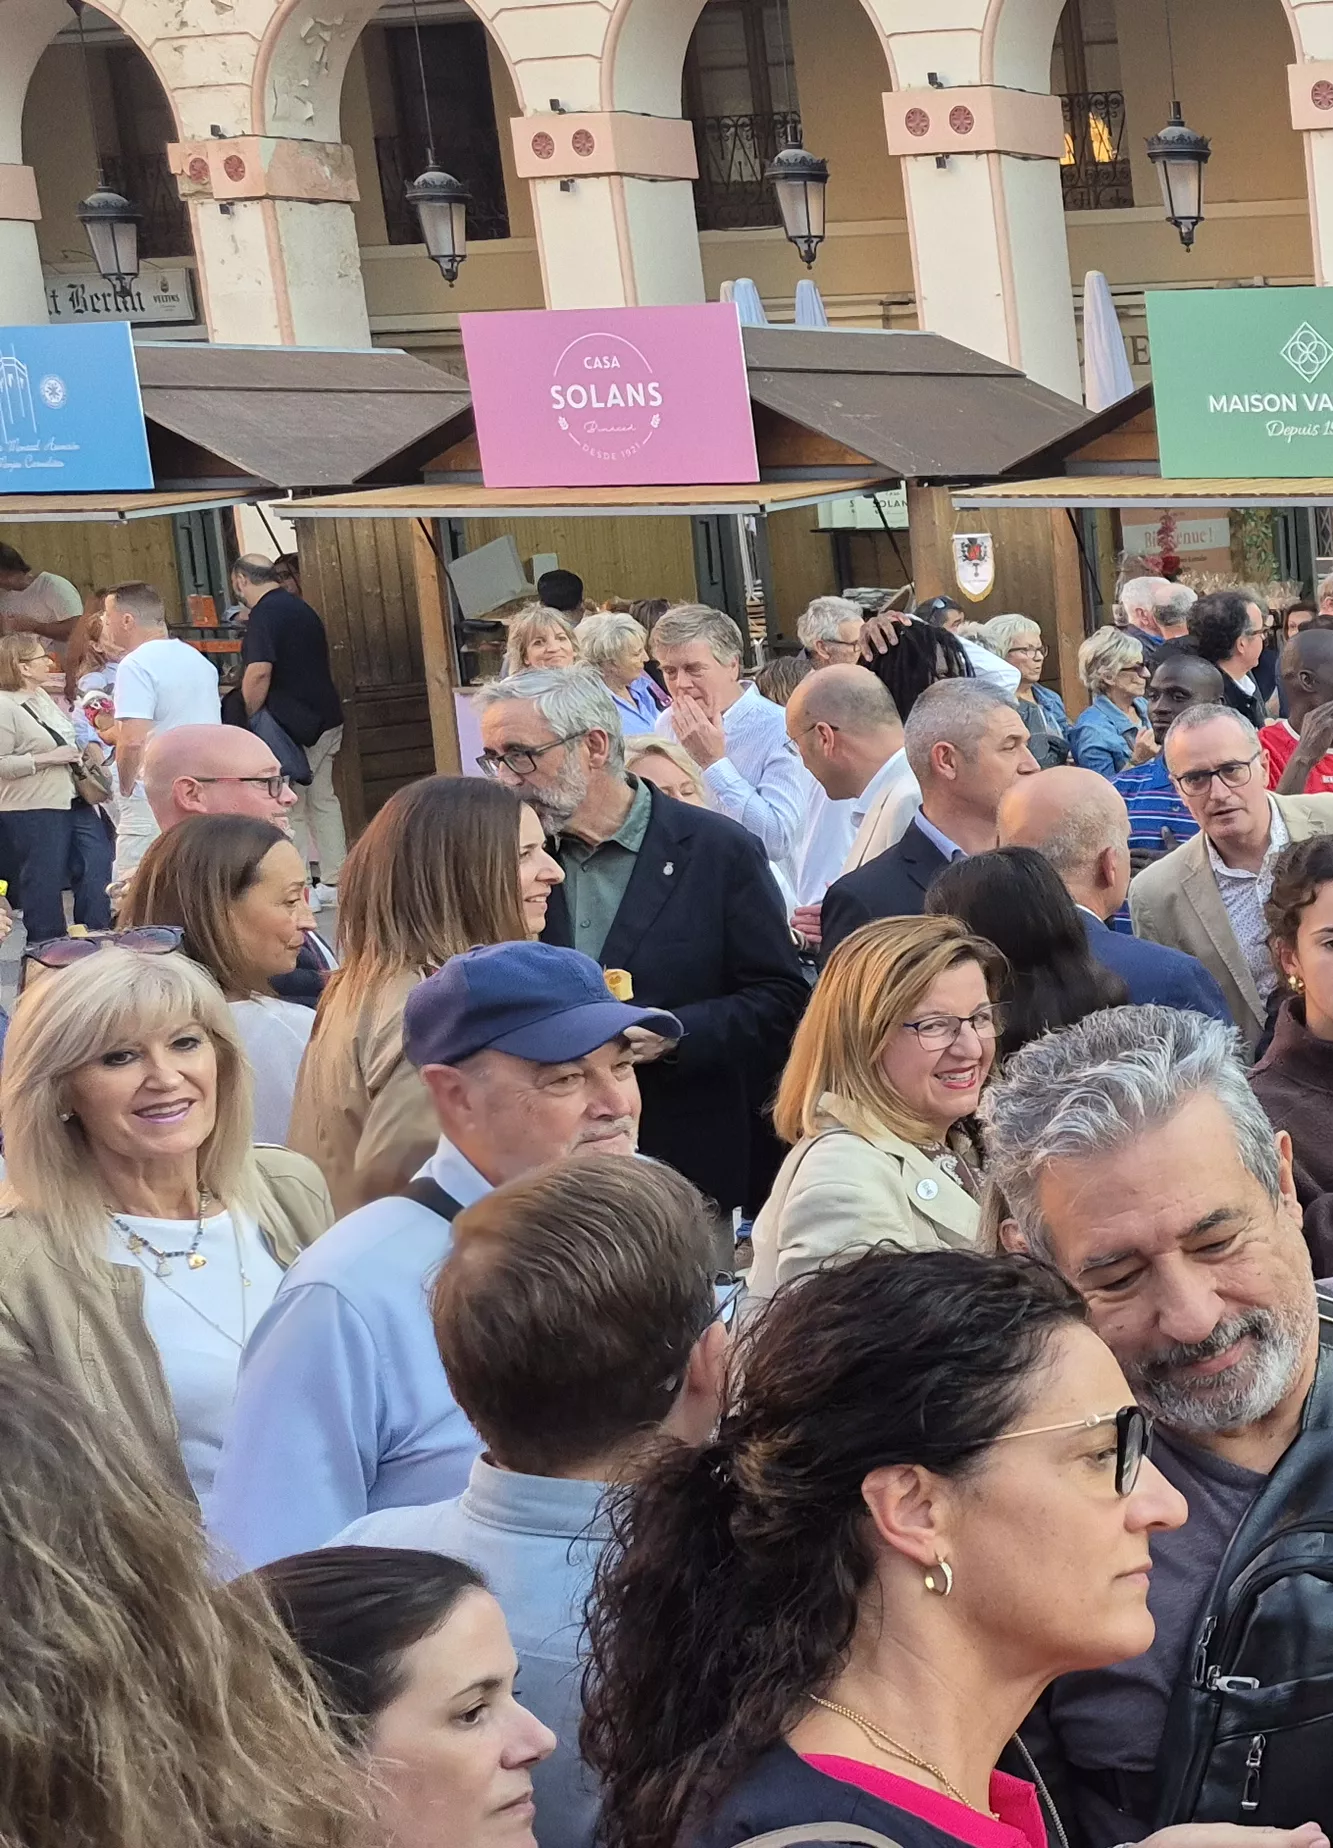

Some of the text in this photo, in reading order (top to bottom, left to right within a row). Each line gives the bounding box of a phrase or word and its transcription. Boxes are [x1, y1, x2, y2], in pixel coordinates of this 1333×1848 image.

[583, 355, 621, 370] CASA
[550, 381, 663, 410] SOLANS
[1209, 394, 1298, 413] MAISON
[1265, 419, 1319, 443] Depuis
[582, 442, 641, 461] DESDE 1921
